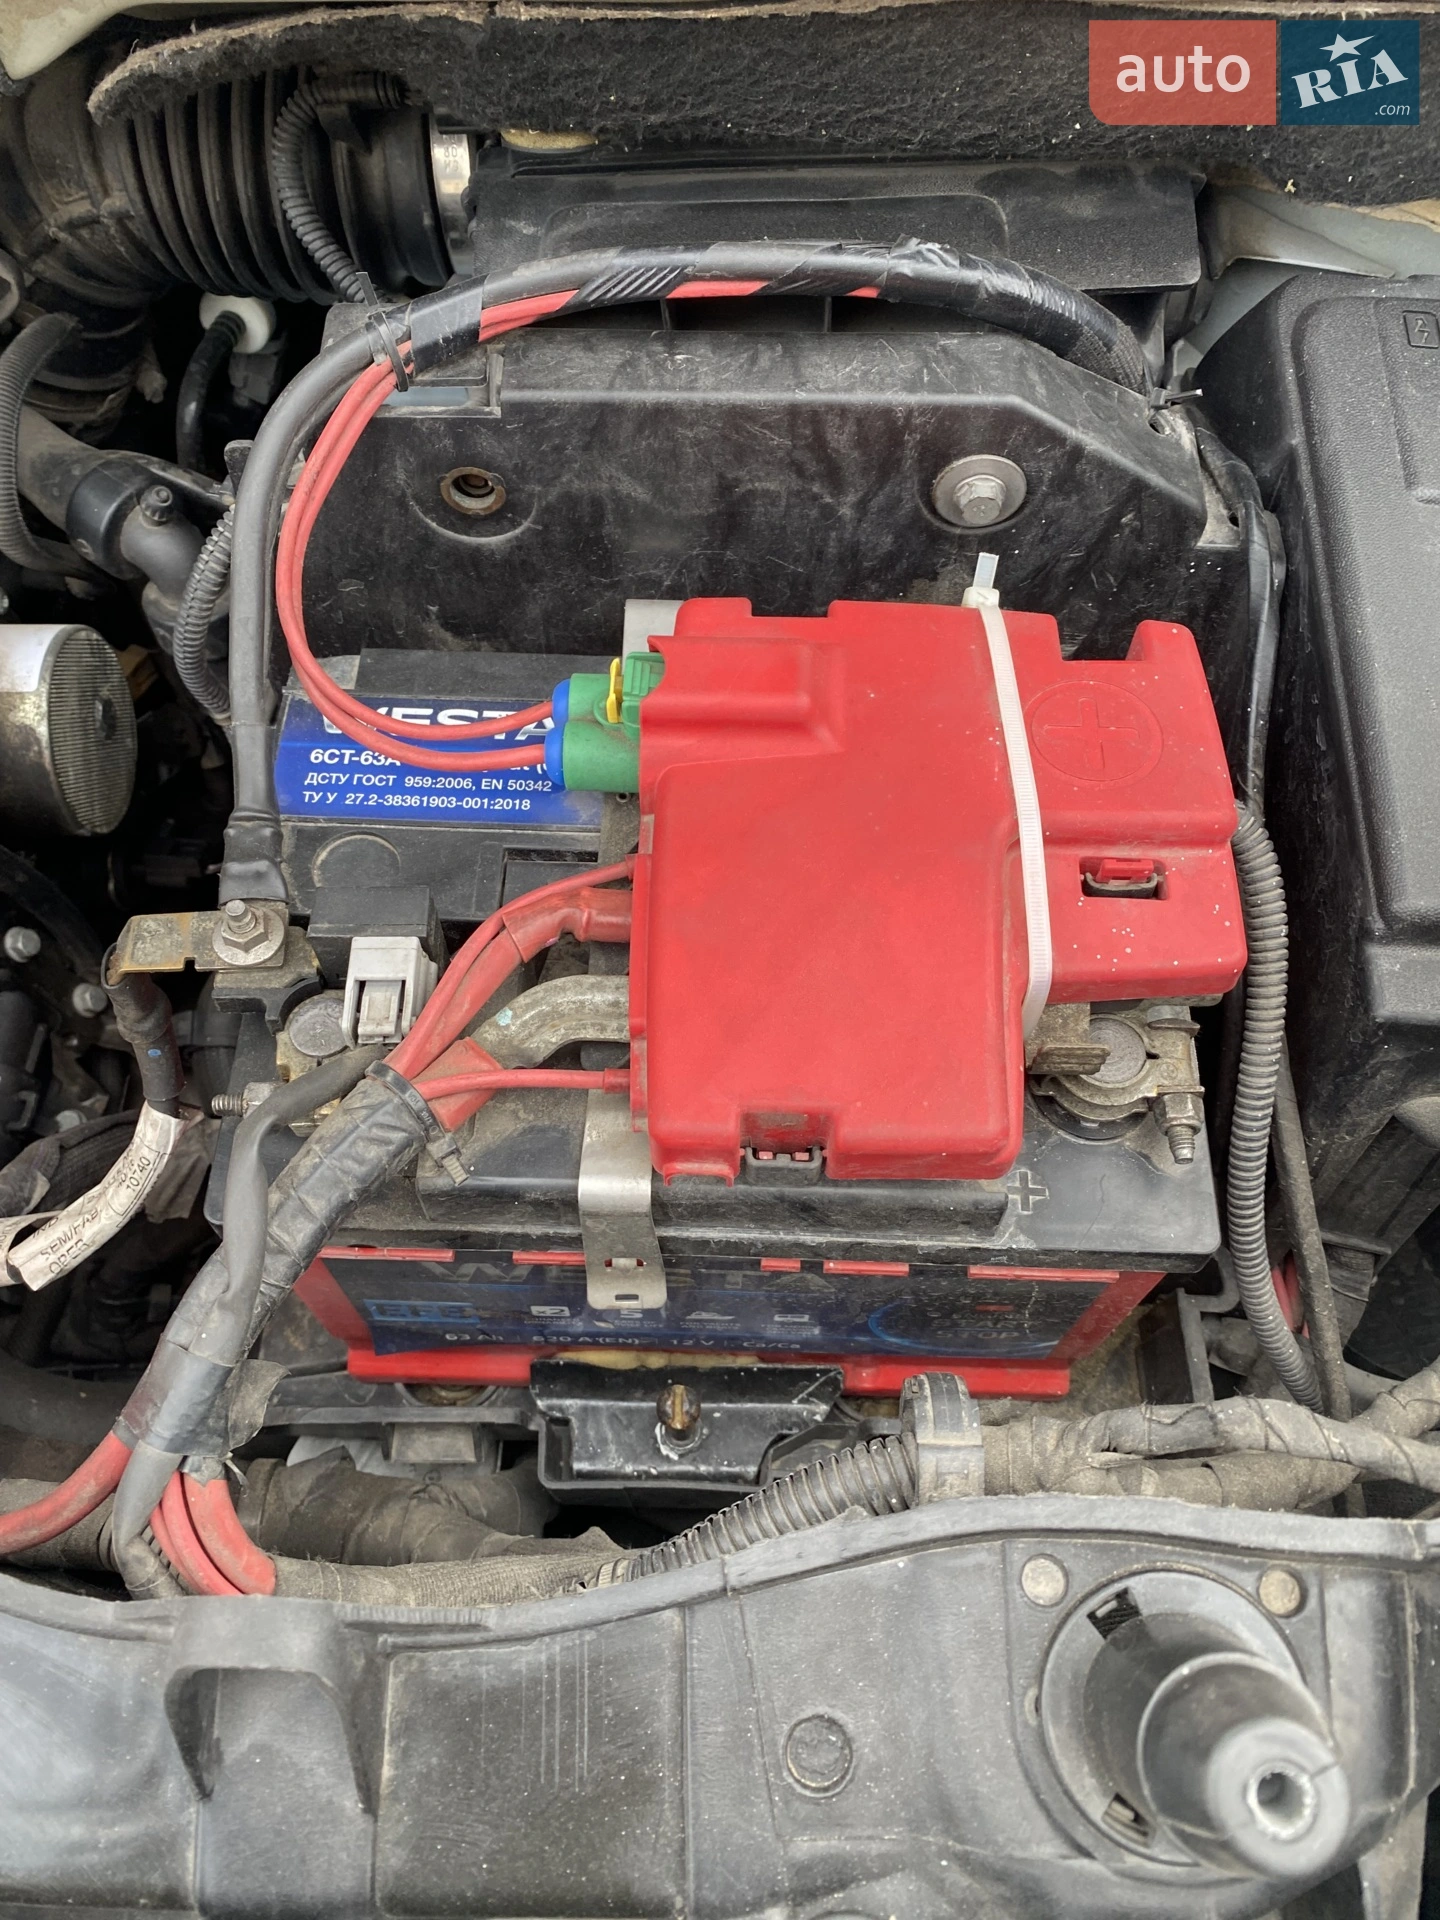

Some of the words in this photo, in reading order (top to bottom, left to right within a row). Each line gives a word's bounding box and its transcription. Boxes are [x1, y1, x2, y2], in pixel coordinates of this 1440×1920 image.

[304, 772, 350, 786] ДСТУ
[353, 773, 397, 786] ГОСТ
[404, 776, 476, 791] 959:2006,
[481, 778, 503, 790] EN
[507, 779, 552, 792] 50342
[344, 793, 531, 811] 27.2-38361903-001:2018
